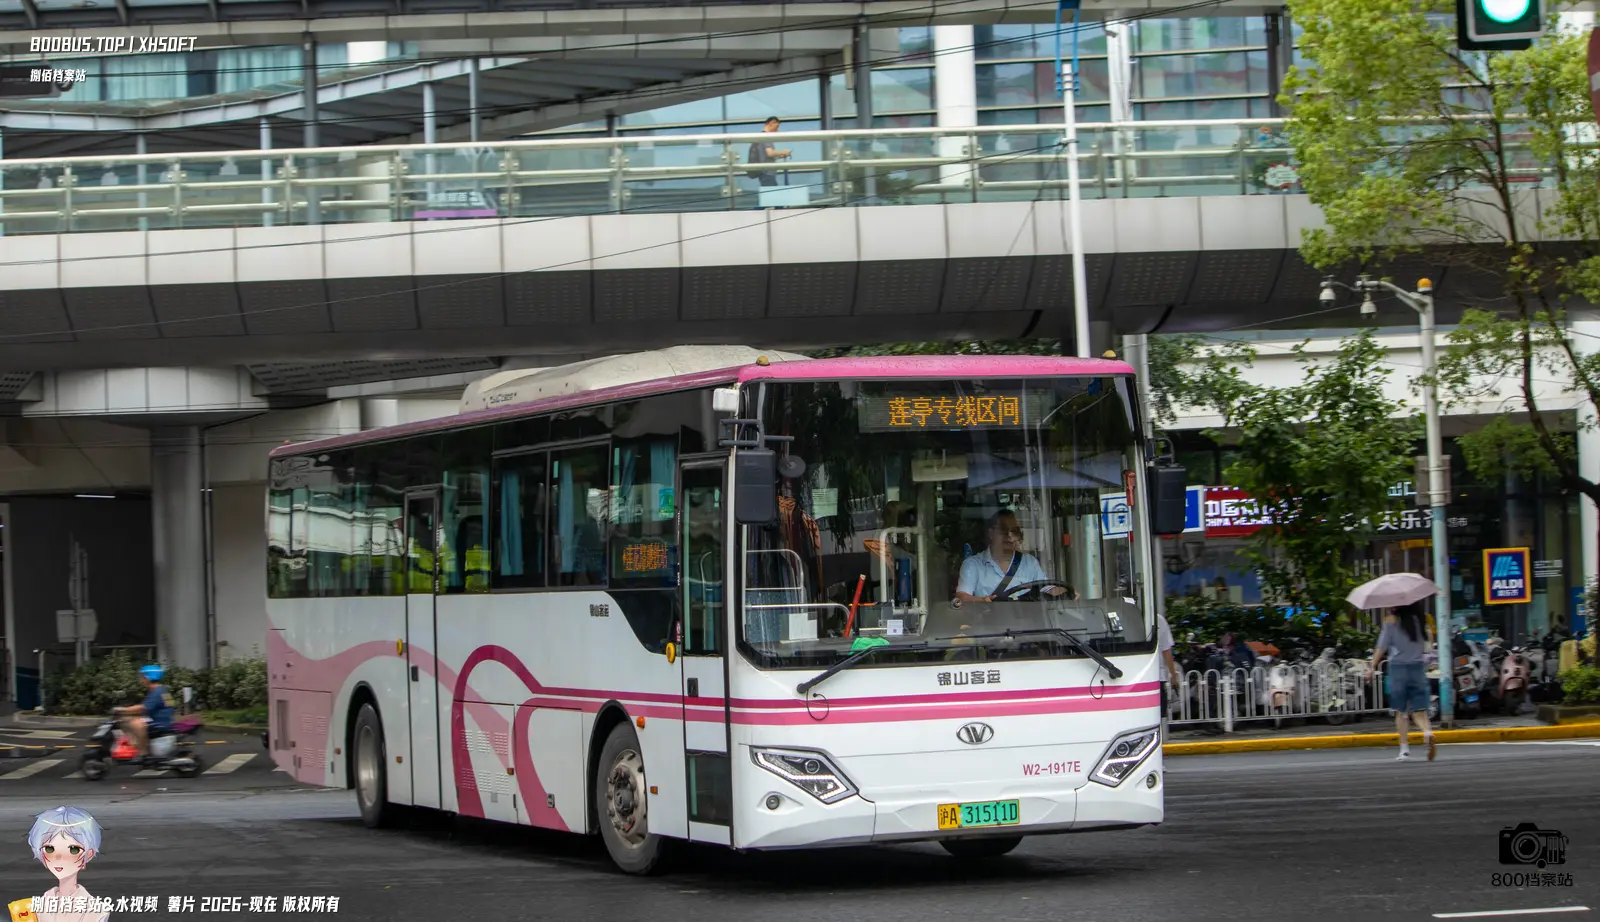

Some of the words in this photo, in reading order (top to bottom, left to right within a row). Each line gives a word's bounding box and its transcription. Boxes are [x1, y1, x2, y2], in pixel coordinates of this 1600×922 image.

[888, 395, 1020, 427] 莲亭专线区间
[1492, 579, 1524, 590] ALDI
[937, 669, 1001, 687] 锦山客运
[1023, 761, 1081, 776] W2-1917E
[940, 808, 958, 826] 沪A
[965, 802, 1018, 824] 31511D
